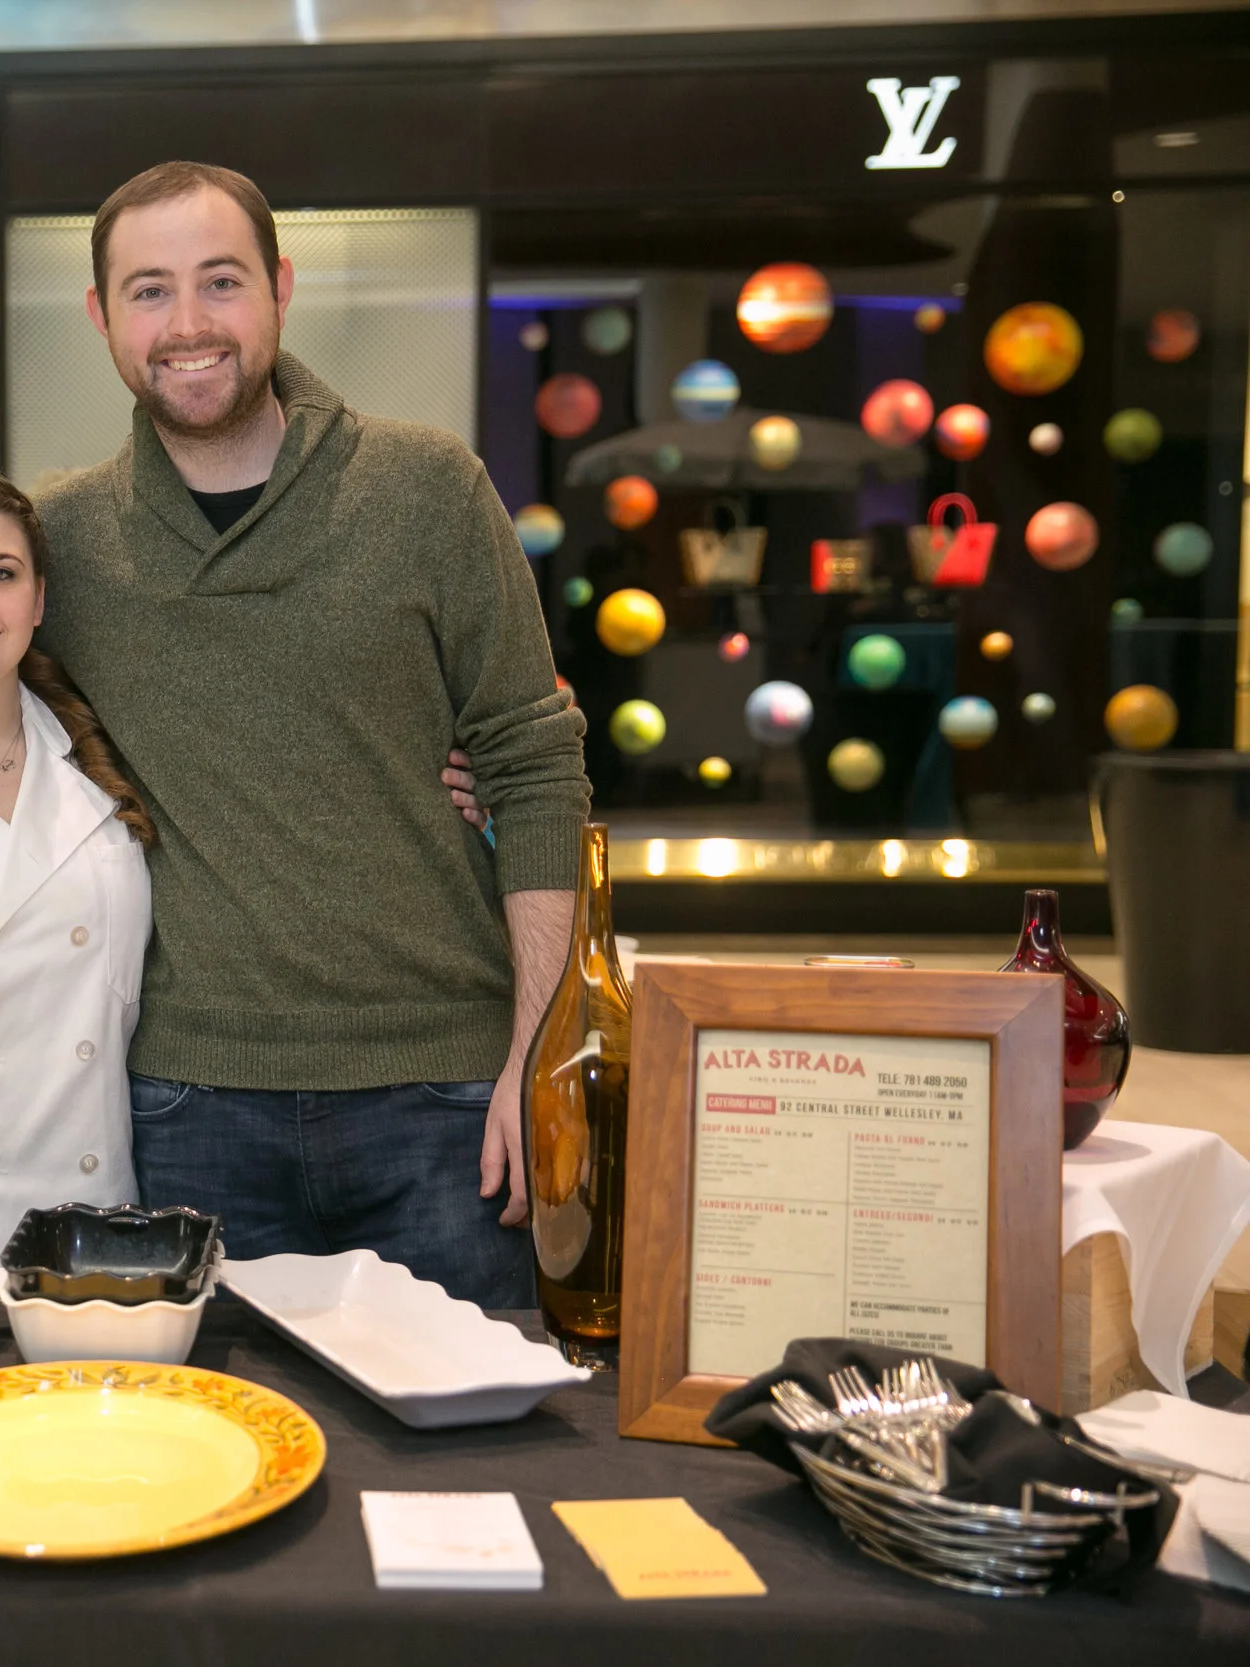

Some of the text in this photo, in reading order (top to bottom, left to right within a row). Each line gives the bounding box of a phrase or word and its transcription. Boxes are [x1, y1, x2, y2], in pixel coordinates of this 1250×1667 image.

[704, 1048, 866, 1078] ALTA STRADA
[877, 1072, 901, 1085] TELE:
[904, 1074, 921, 1086] 781
[780, 1101, 792, 1112] 92
[796, 1102, 838, 1115] CENTRAL
[844, 1104, 880, 1117] STREET
[948, 1110, 963, 1121] MA
